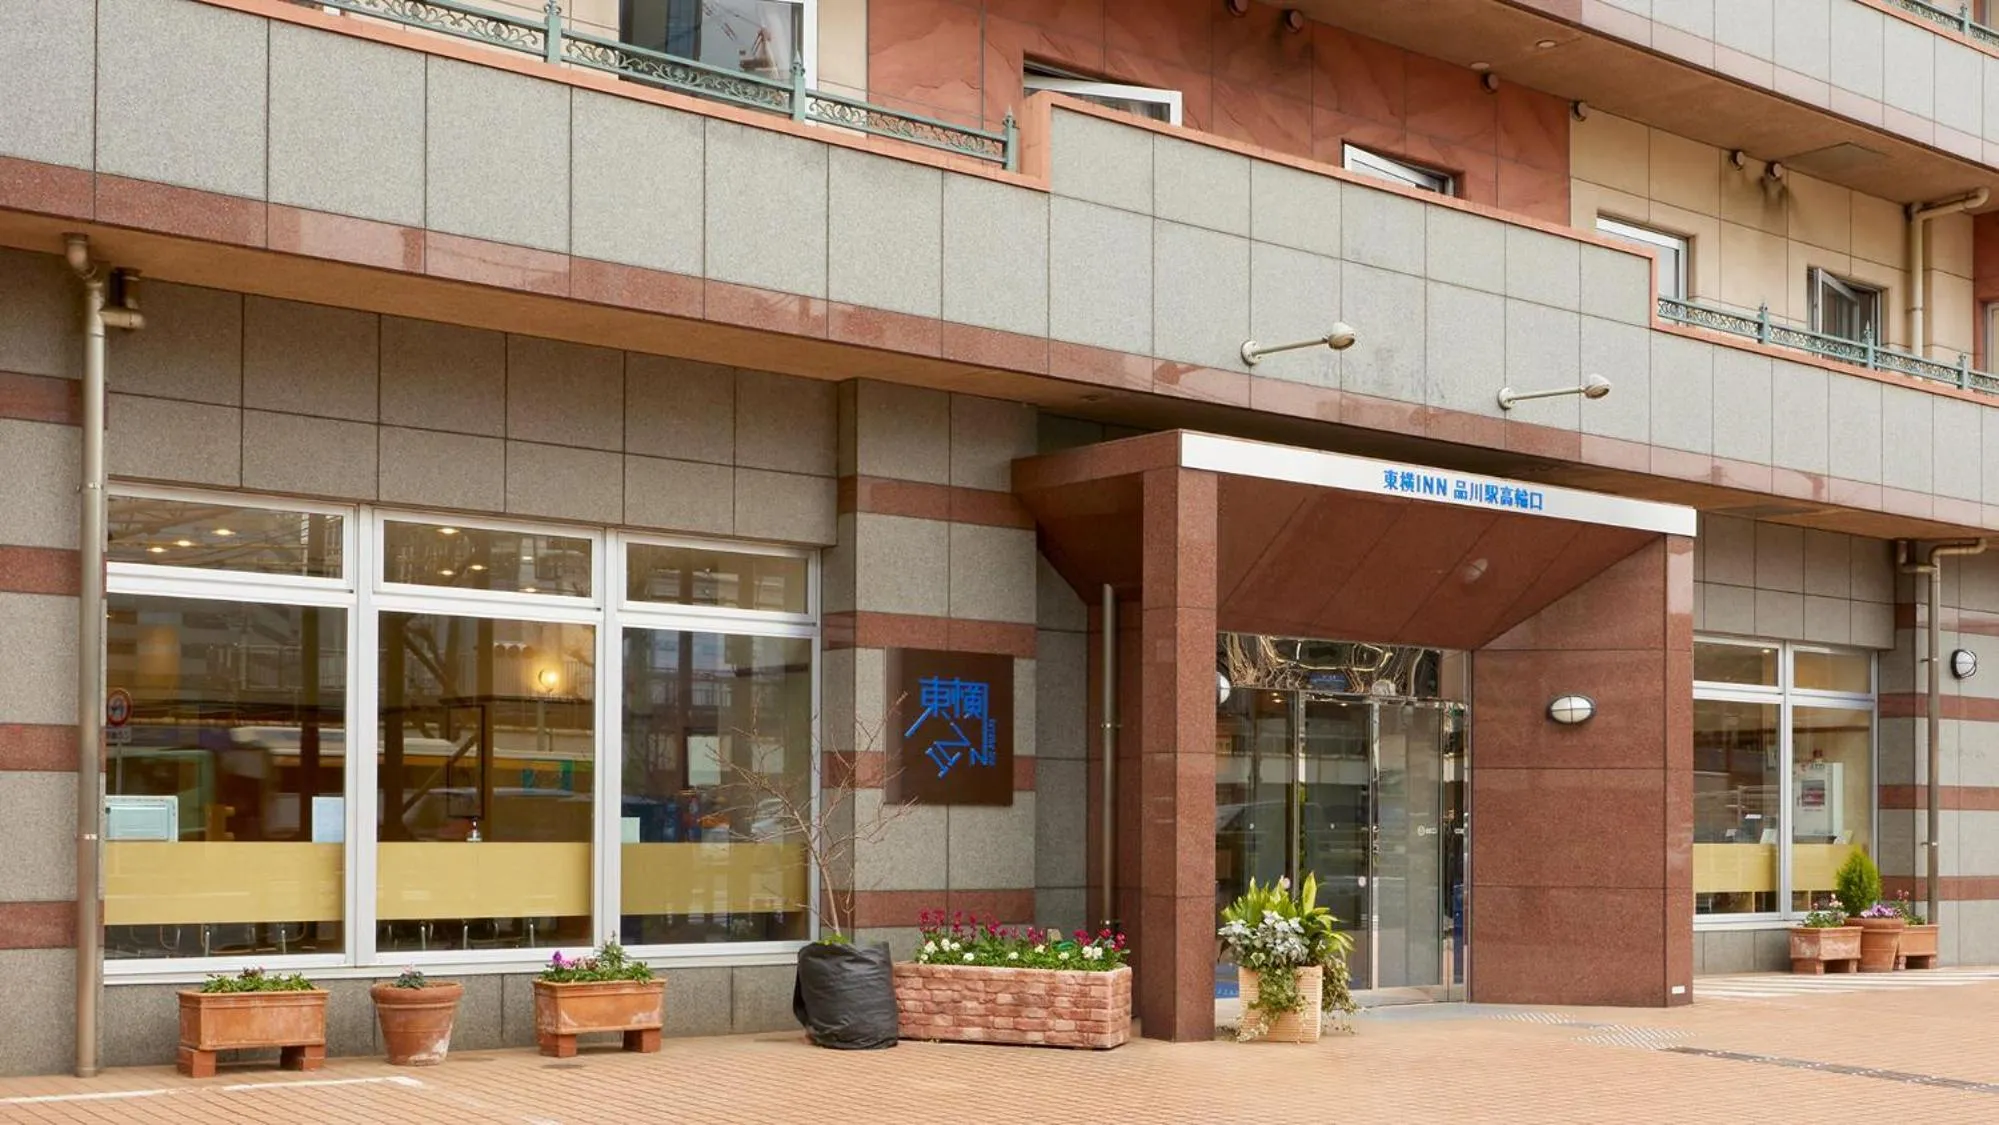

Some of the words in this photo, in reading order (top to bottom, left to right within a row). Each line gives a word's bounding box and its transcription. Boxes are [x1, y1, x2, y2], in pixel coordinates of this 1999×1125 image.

[1384, 469, 1448, 496] 東横INN
[1453, 480, 1544, 511] 品川駅高輪口
